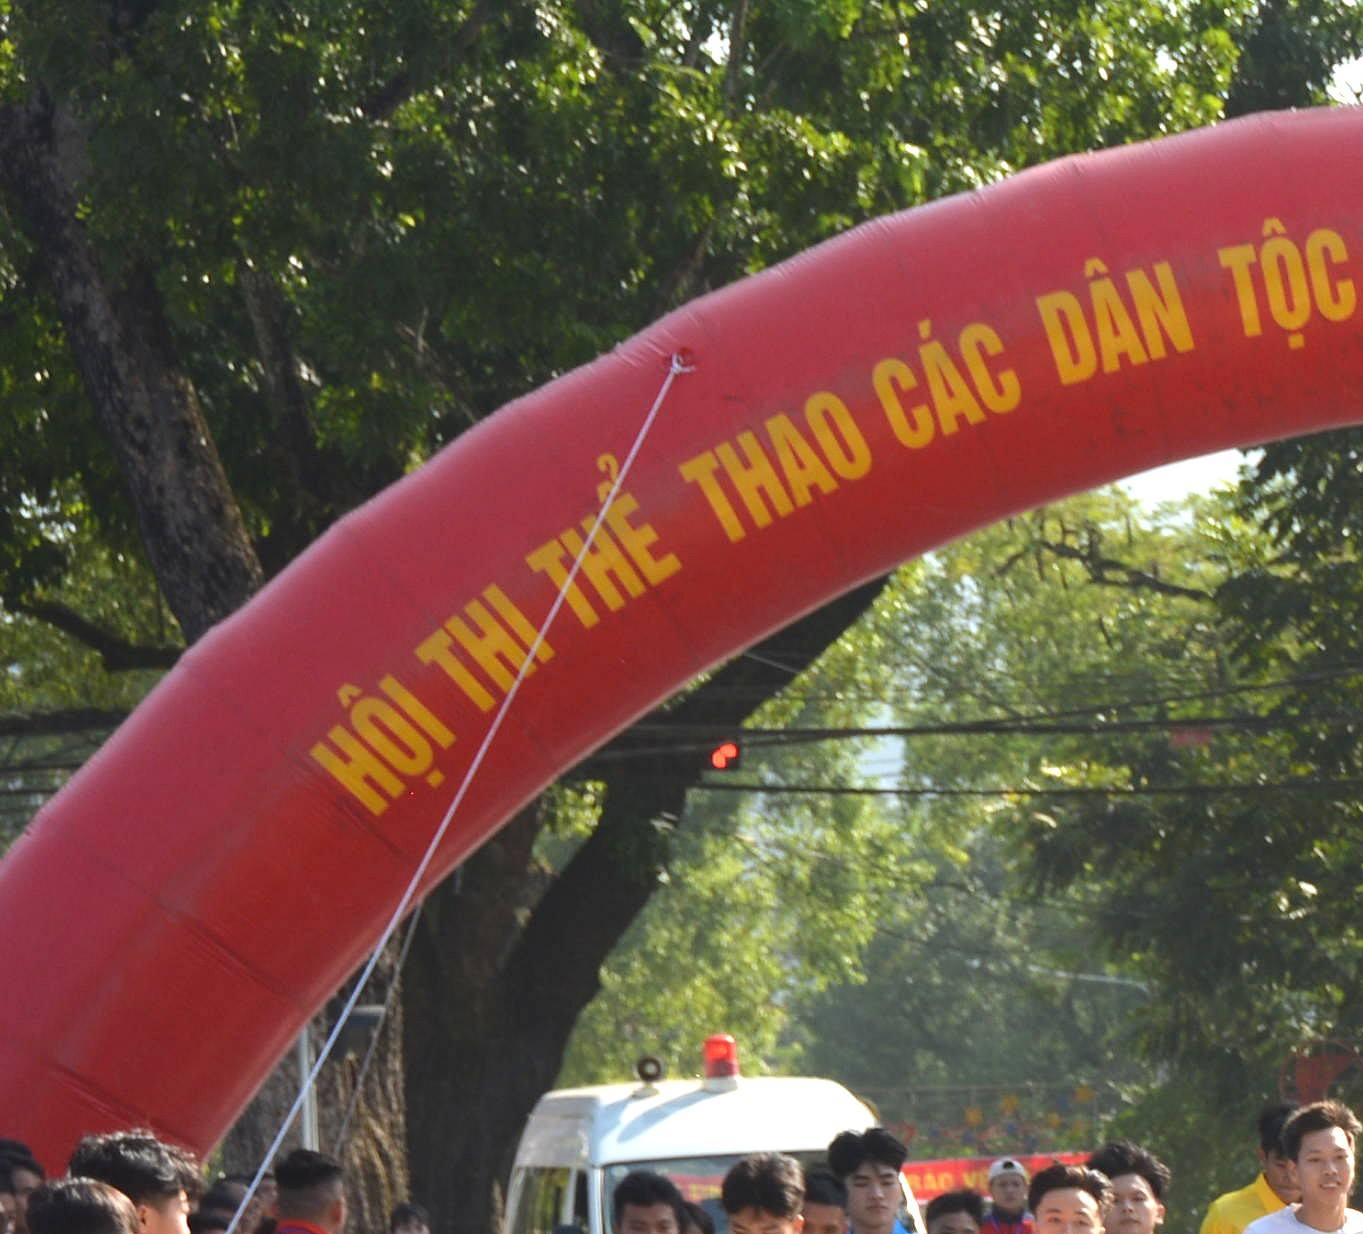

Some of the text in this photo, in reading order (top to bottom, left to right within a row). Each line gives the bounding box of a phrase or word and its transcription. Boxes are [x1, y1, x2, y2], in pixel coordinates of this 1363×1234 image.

[310, 674, 456, 816] HỘI
[414, 584, 555, 713] THI
[525, 453, 683, 630] THỂ
[679, 391, 873, 543] THAO
[872, 319, 1021, 449] CÁC
[1036, 259, 1195, 385] DÂN
[1219, 218, 1356, 349] TỘC
